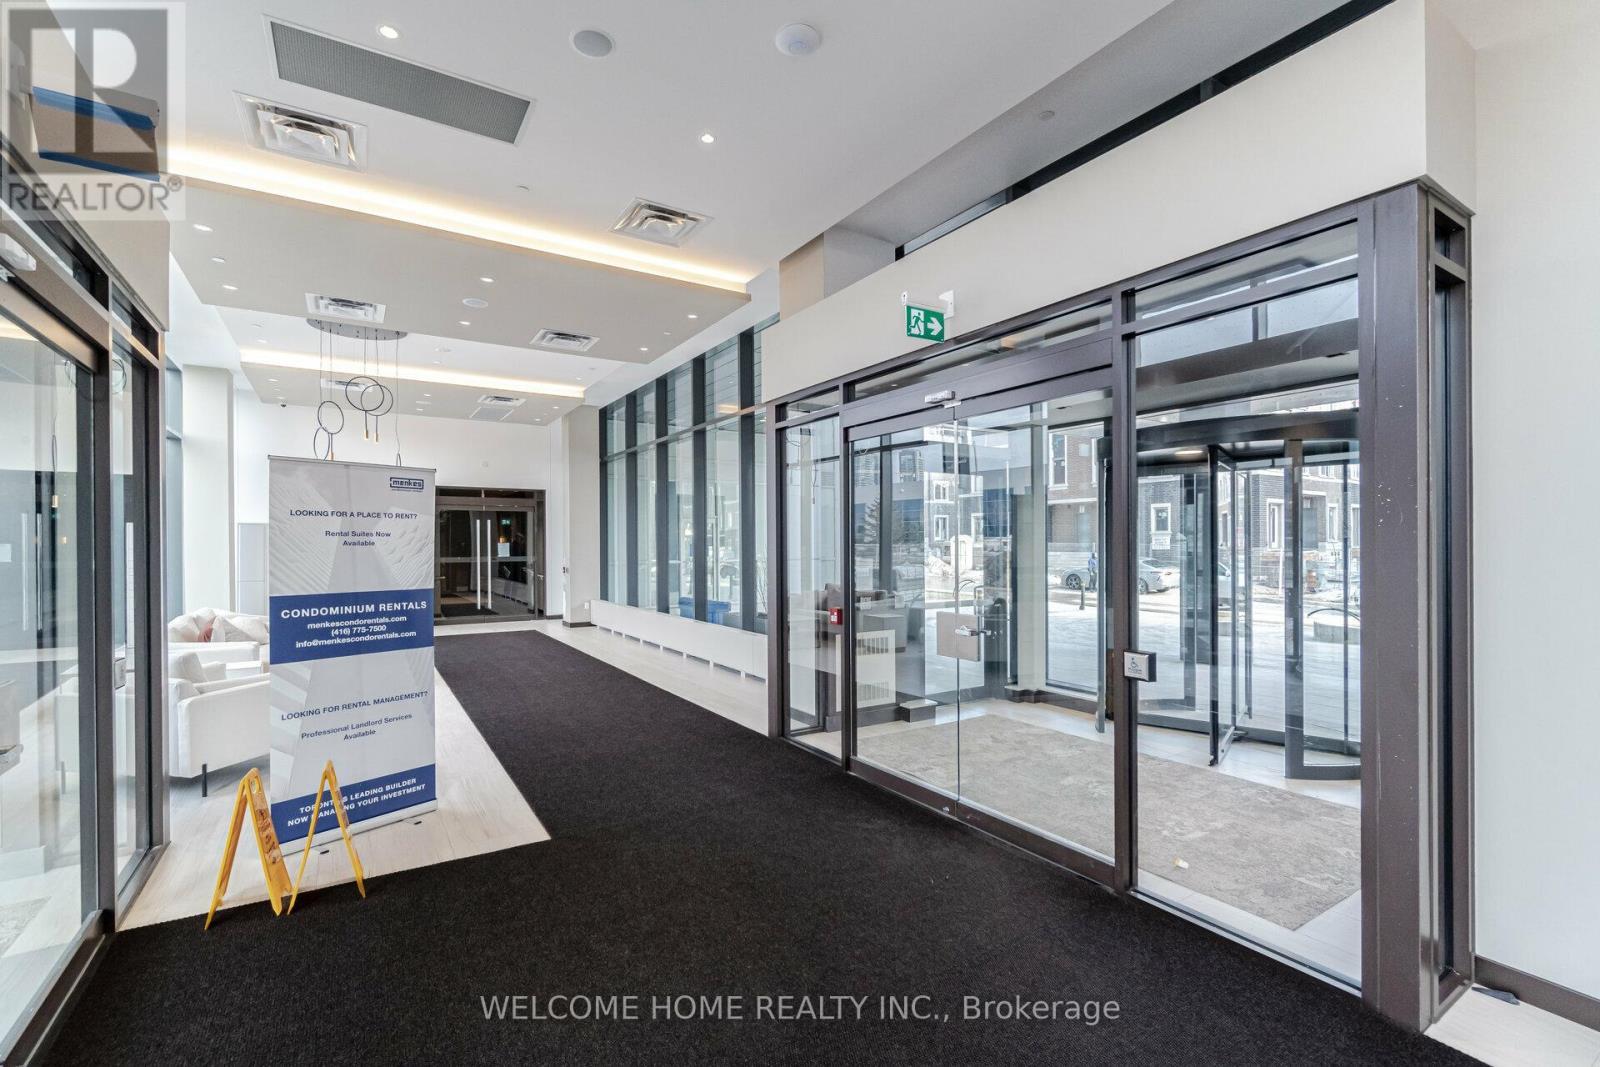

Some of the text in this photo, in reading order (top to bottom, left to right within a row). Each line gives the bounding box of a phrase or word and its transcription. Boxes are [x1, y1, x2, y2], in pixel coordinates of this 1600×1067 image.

[391, 478, 423, 488] menkes
[289, 509, 329, 517] LOOKING
[331, 510, 348, 518] FOR
[357, 511, 381, 519] PLACE
[395, 512, 417, 520] RENT?
[281, 600, 427, 619] CONDOMINIUM RENTALS
[307, 615, 407, 630] menkescondorentals.com
[331, 625, 387, 637] (416) 775-7500
[295, 631, 417, 648] info@menkescondorentals.com
[281, 690, 428, 721] LOOKING FOR RENTAL MANAGEMENT?
[301, 713, 412, 740] Professional Landlord Services
[343, 729, 377, 741] Available
[350, 786, 383, 801] LEADING
[385, 777, 417, 791] BUILDER
[287, 815, 309, 827] NOW
[357, 796, 379, 807] YOUR
[380, 783, 426, 801] INVESTMENT
